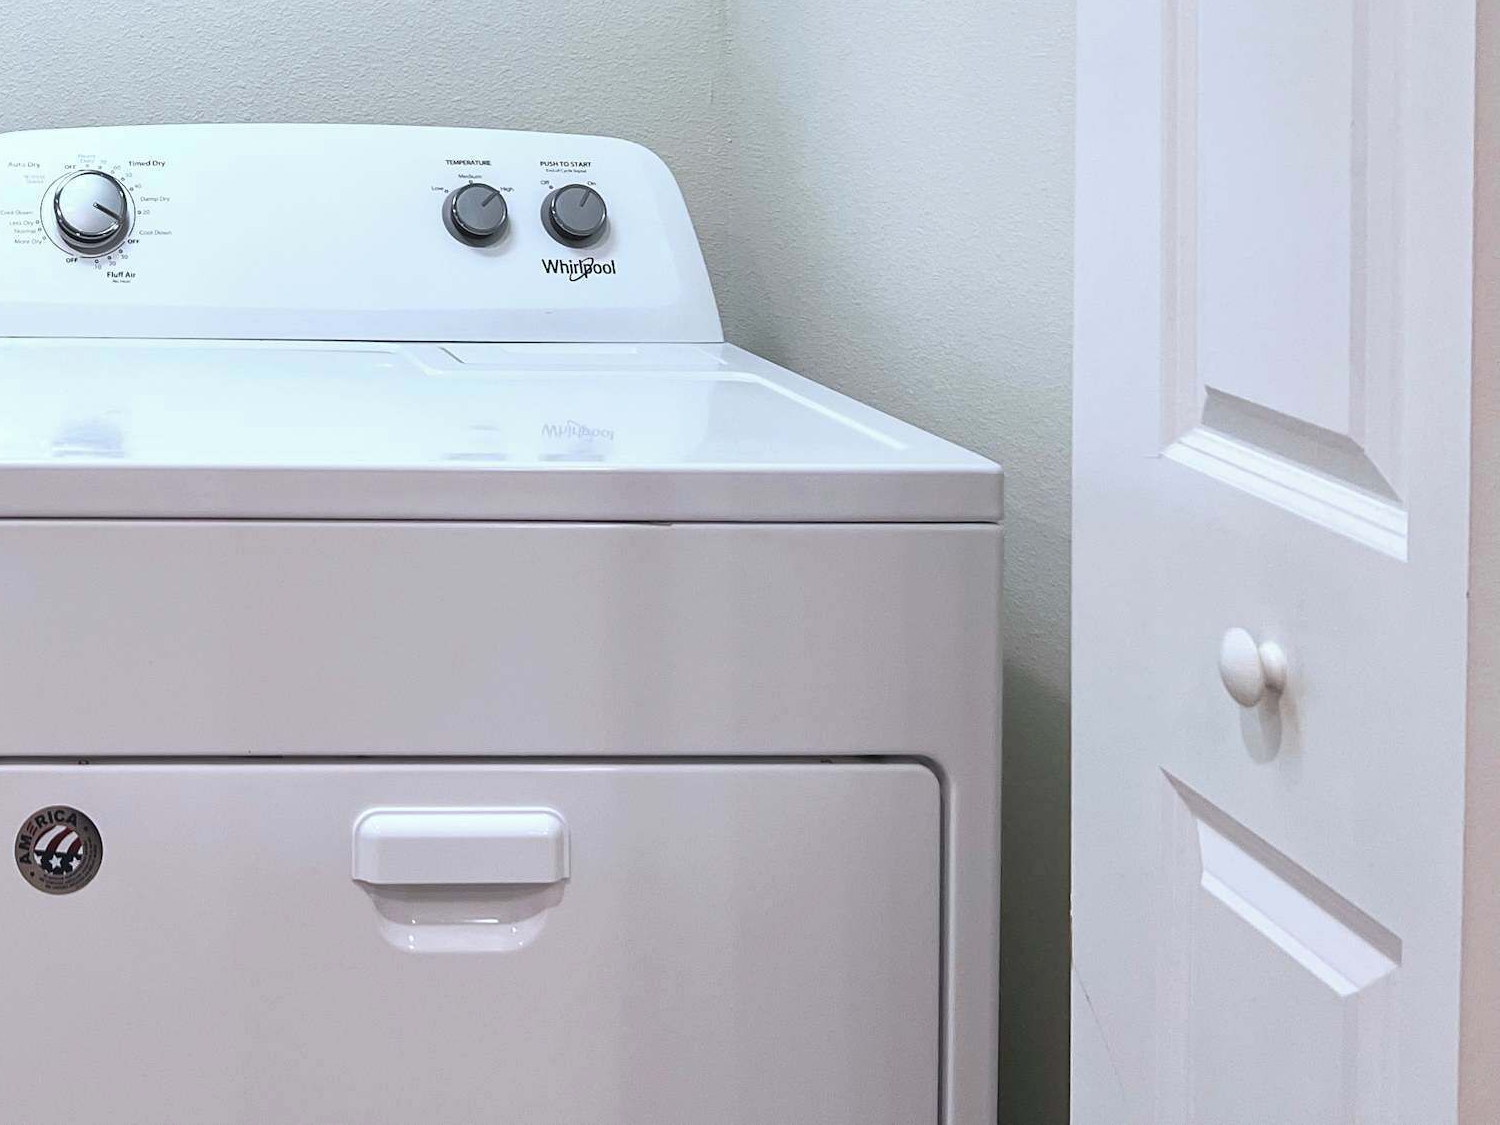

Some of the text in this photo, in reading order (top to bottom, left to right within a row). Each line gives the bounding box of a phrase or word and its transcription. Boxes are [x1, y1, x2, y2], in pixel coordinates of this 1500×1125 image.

[152, 160, 166, 168] Dry
[541, 257, 616, 282] Whirlpool
[19, 810, 78, 865] AMERICA
